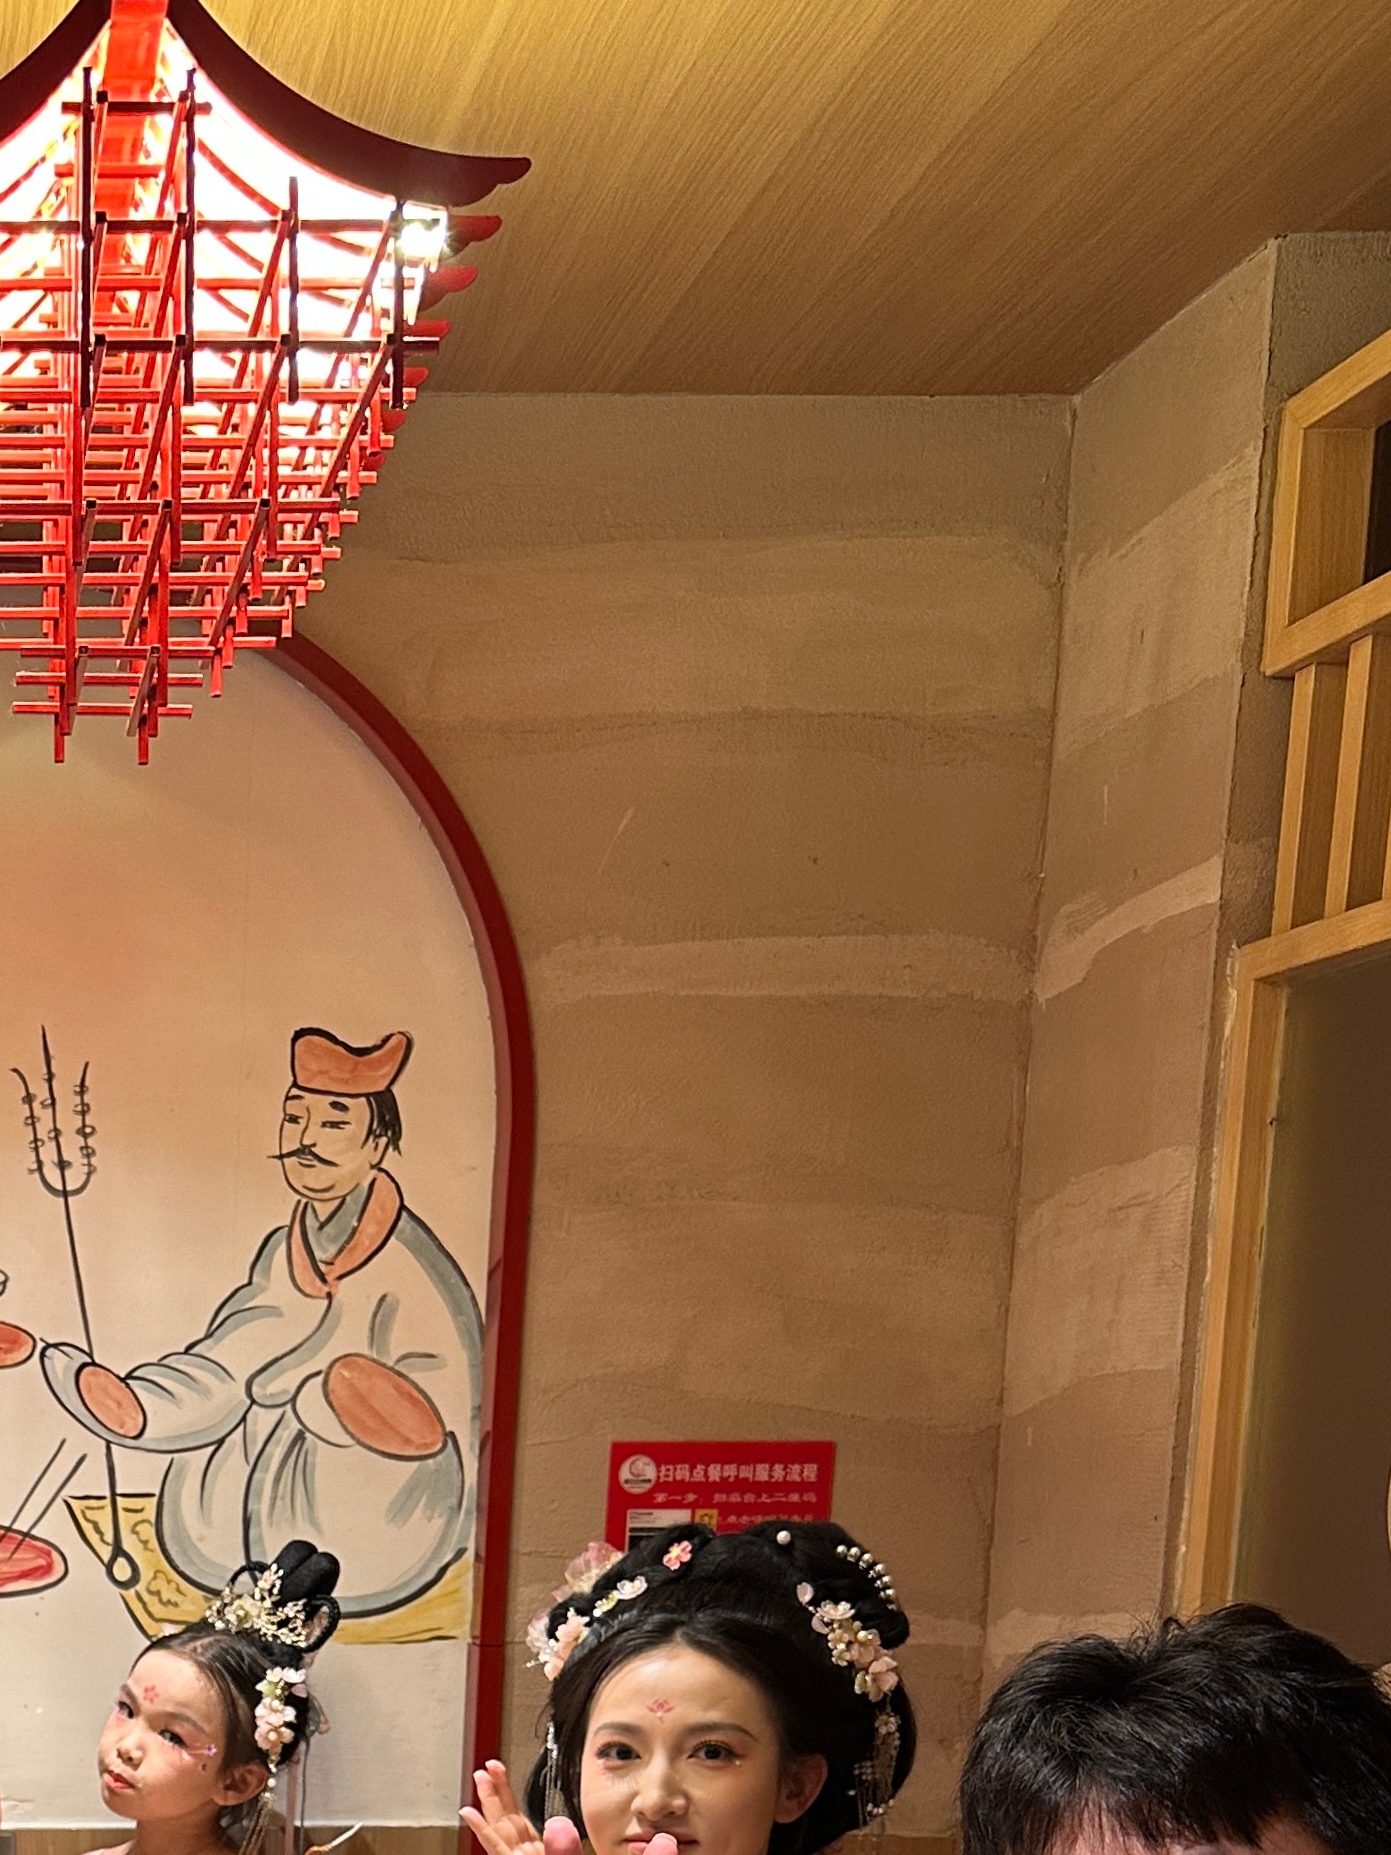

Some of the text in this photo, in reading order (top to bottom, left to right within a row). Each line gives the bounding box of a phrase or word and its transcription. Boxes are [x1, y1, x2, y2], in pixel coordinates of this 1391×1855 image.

[659, 1464, 817, 1482] 扫码点餐呼叫服务流程
